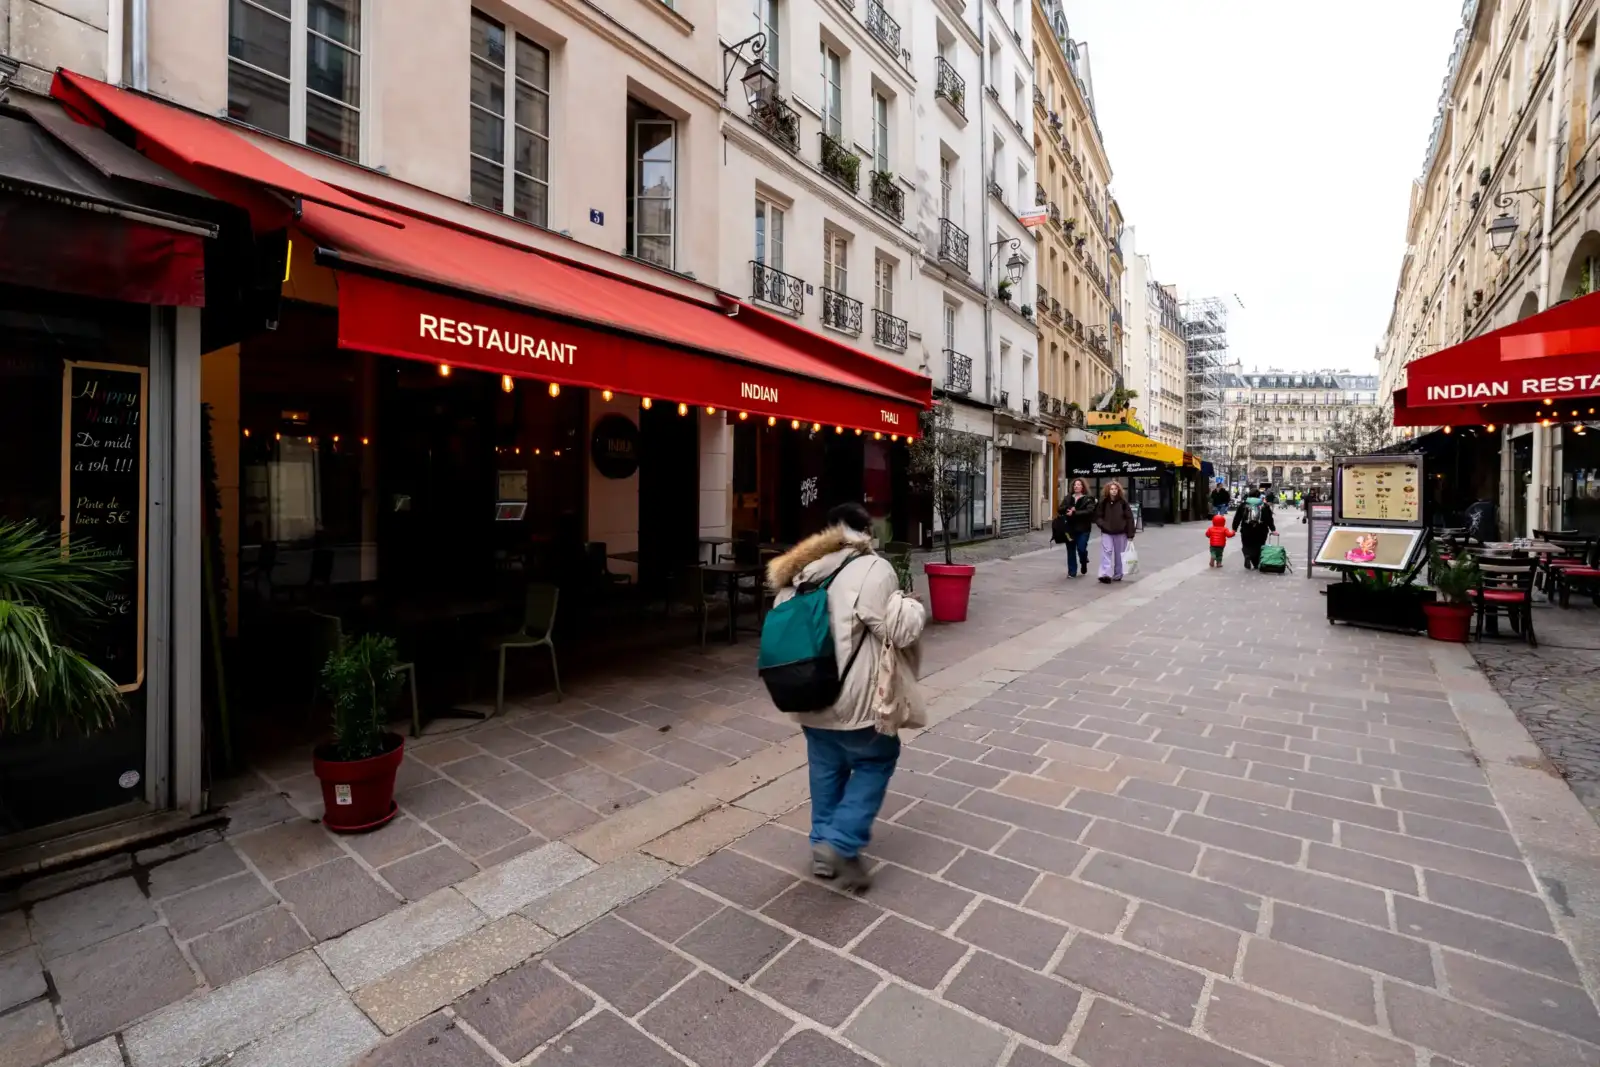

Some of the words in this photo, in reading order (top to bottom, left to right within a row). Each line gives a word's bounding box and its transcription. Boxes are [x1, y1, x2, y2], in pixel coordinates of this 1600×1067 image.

[419, 313, 578, 365] RESTAURANT
[740, 382, 779, 403] INDIAN
[1427, 380, 1509, 400] INDIAN
[880, 409, 899, 425] THALI
[74, 431, 101, 449] De
[104, 432, 133, 449] midi
[87, 456, 109, 472] 19h
[76, 496, 105, 510] Pinte
[106, 496, 121, 509] de
[105, 509, 132, 525] 5€
